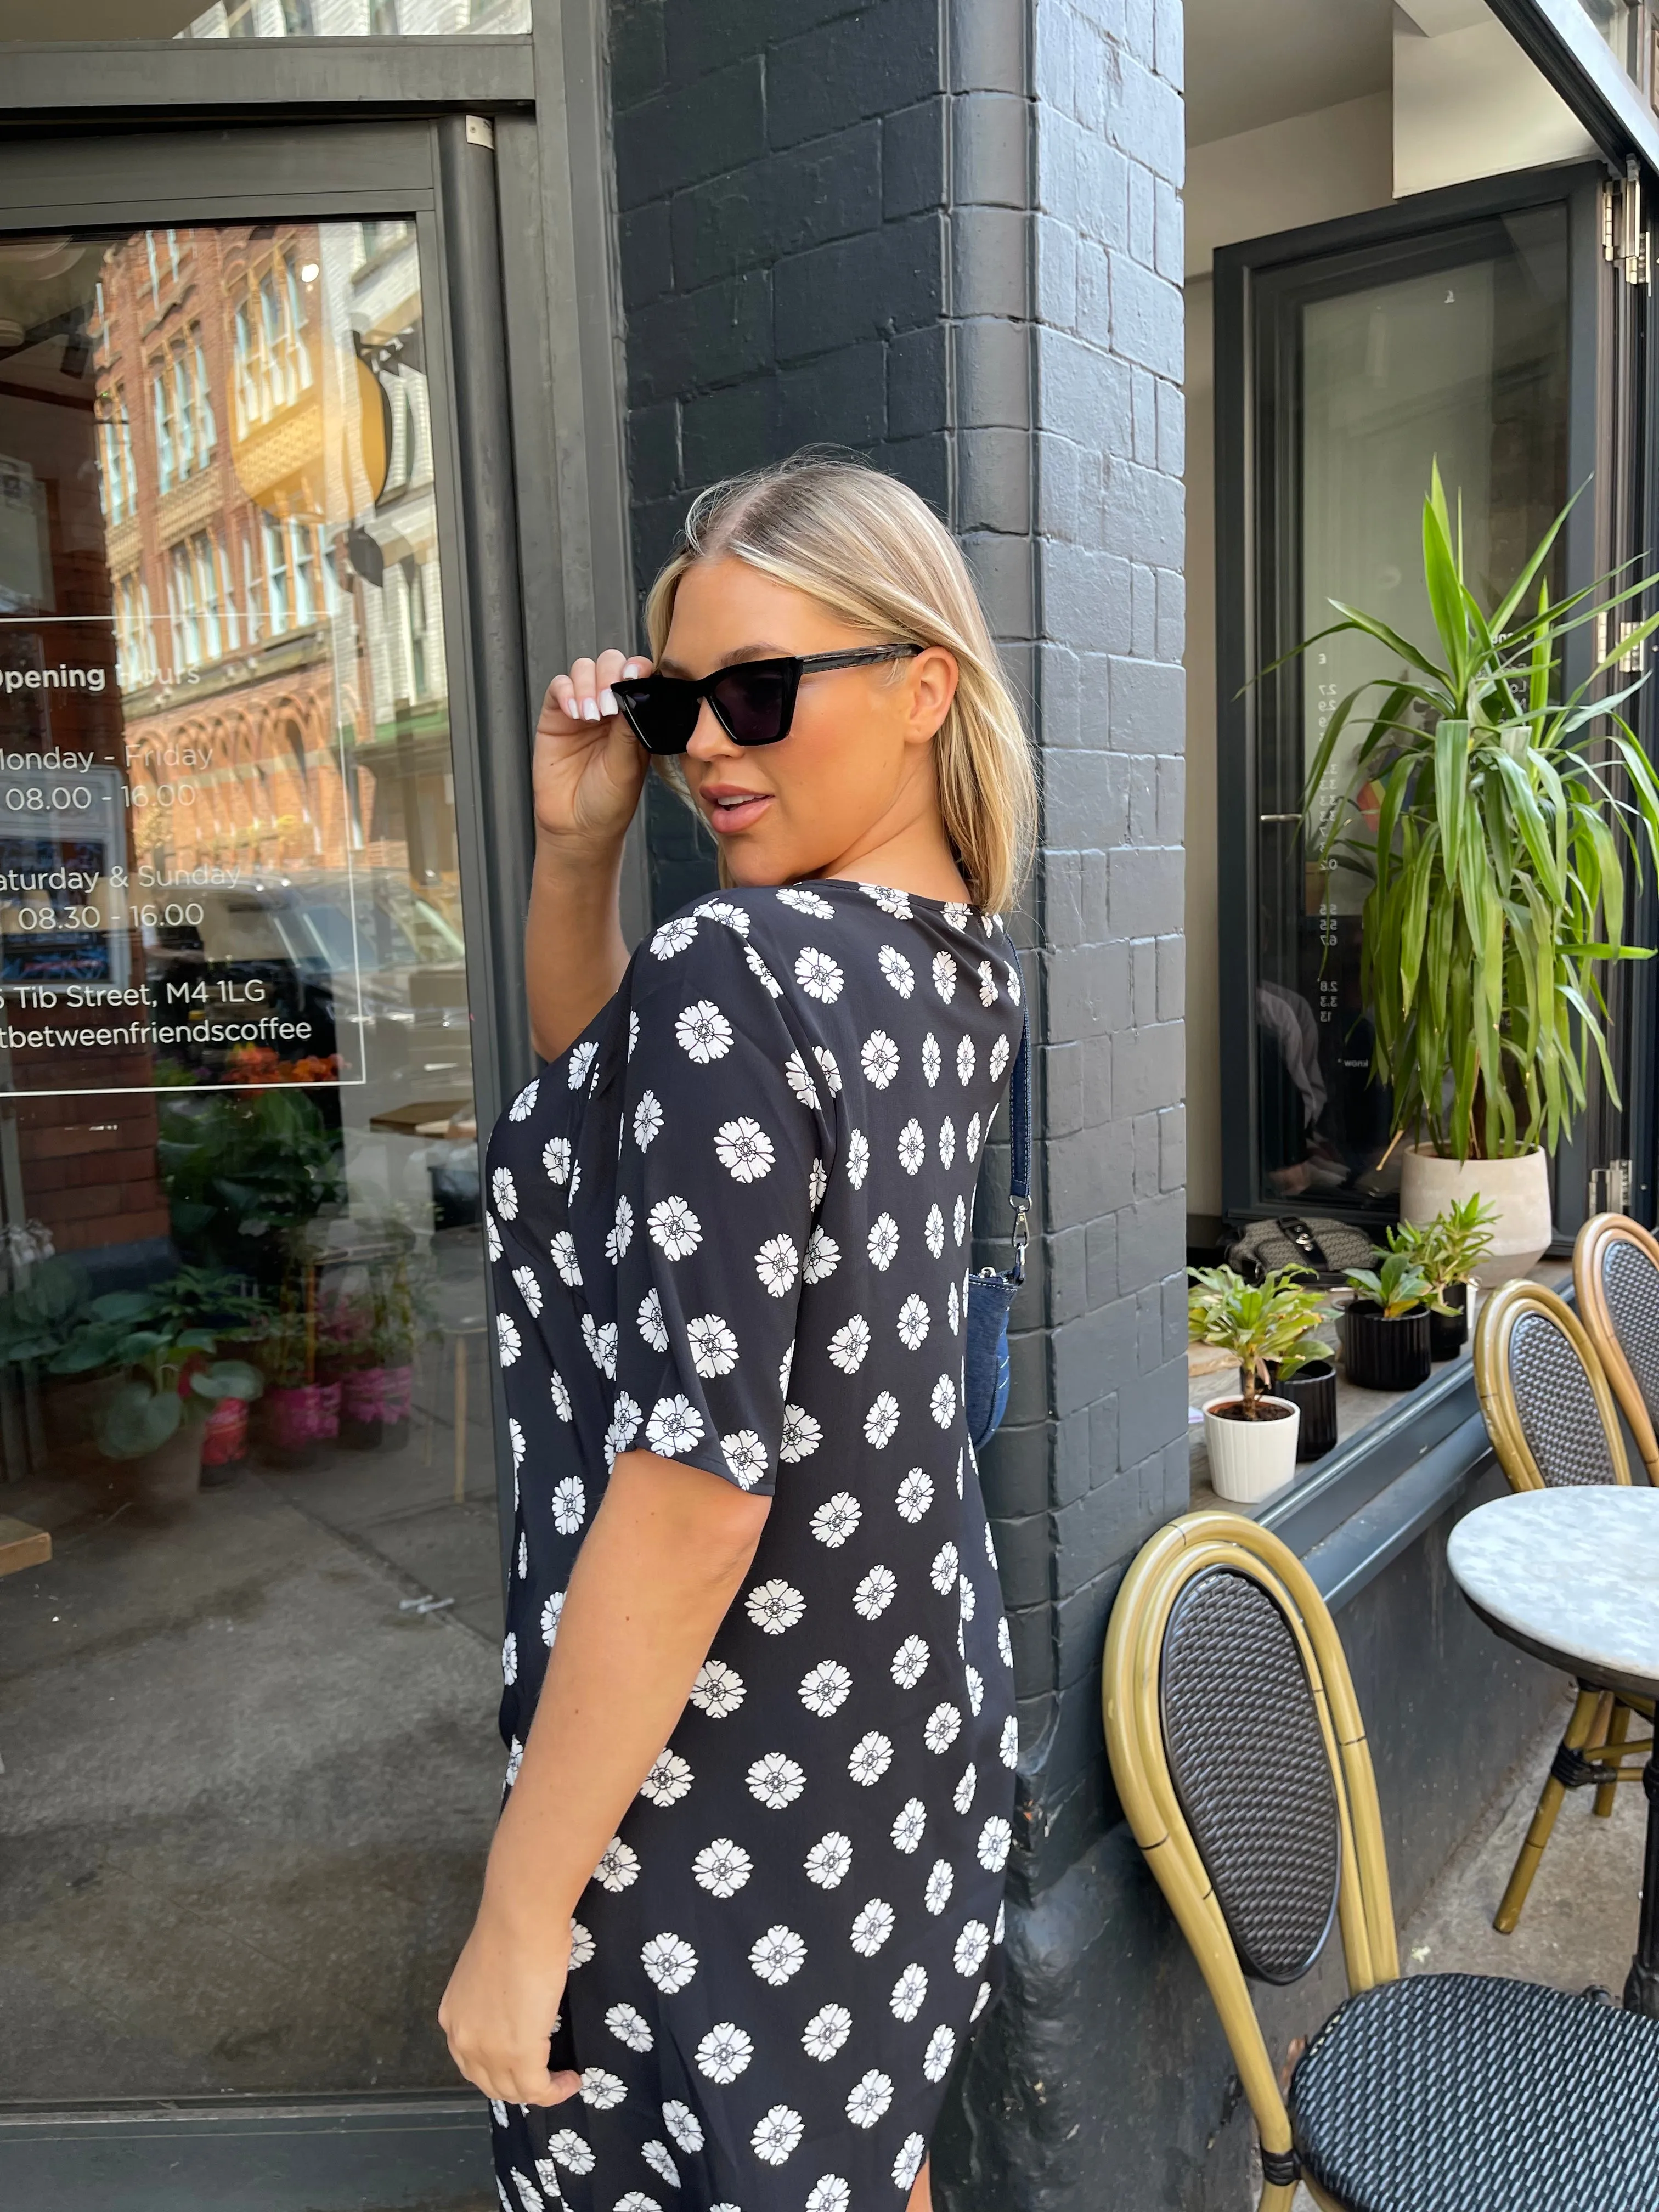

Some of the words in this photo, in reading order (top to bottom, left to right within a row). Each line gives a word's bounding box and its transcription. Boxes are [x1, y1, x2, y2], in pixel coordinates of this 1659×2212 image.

[0, 664, 106, 694] pening
[125, 743, 213, 770] Friday
[5, 786, 92, 811] 08.00
[120, 784, 196, 808] 16.00
[109, 865, 129, 888] &
[138, 864, 241, 889] Sunday
[18, 905, 101, 930] 08.30
[129, 902, 204, 928] 16.00
[13, 986, 57, 1009] Tib
[66, 984, 157, 1008] Street,
[166, 980, 210, 1004] M4
[216, 979, 266, 1003] 1LG
